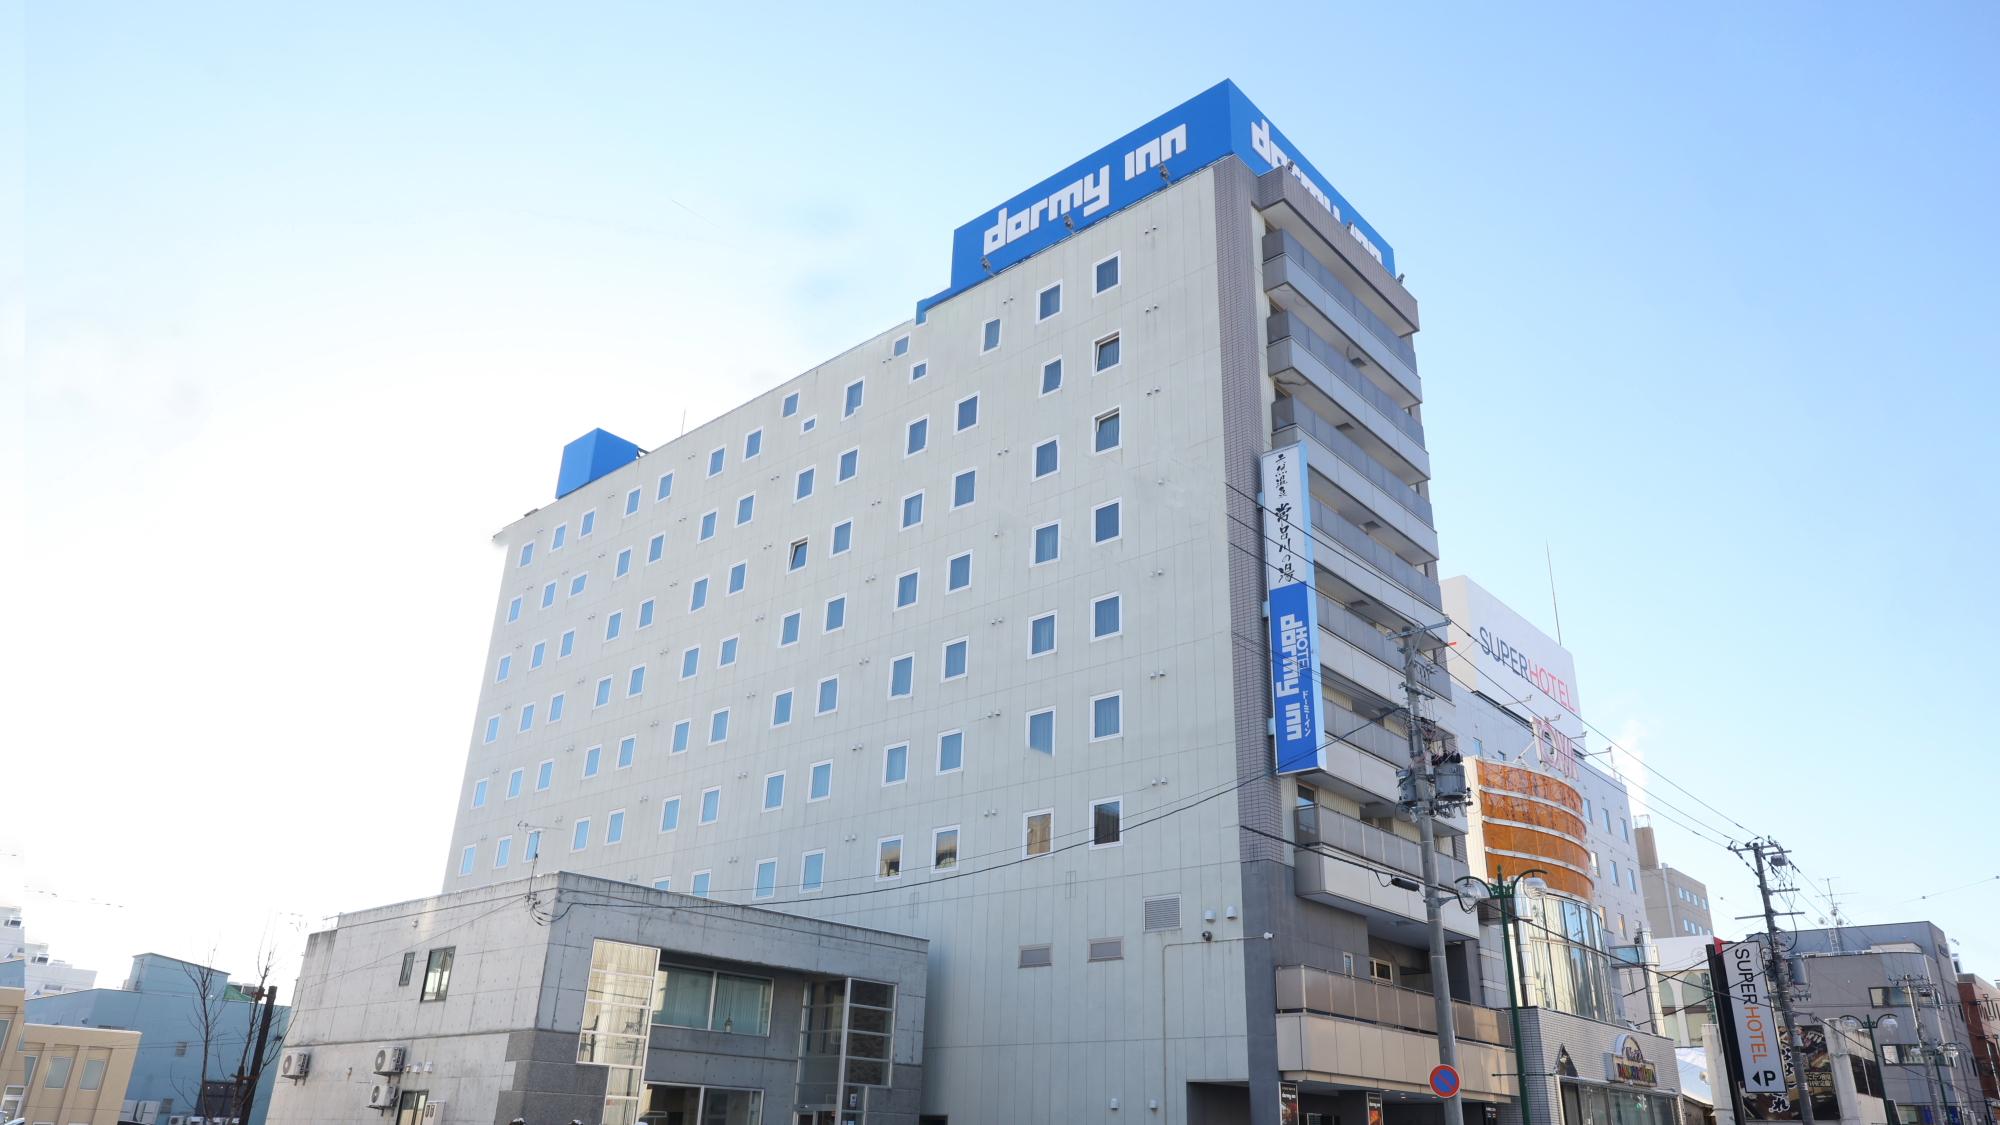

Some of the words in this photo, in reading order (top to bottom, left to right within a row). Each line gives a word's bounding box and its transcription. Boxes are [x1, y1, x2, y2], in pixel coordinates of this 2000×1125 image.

[984, 164, 1110, 256] dormy
[1125, 123, 1187, 181] inn
[1275, 613, 1303, 698] dormy
[1295, 626, 1310, 677] HOTEL
[1285, 702, 1303, 741] inn
[1302, 690, 1312, 737] ドーミーイン
[1763, 1070, 1776, 1087] P
